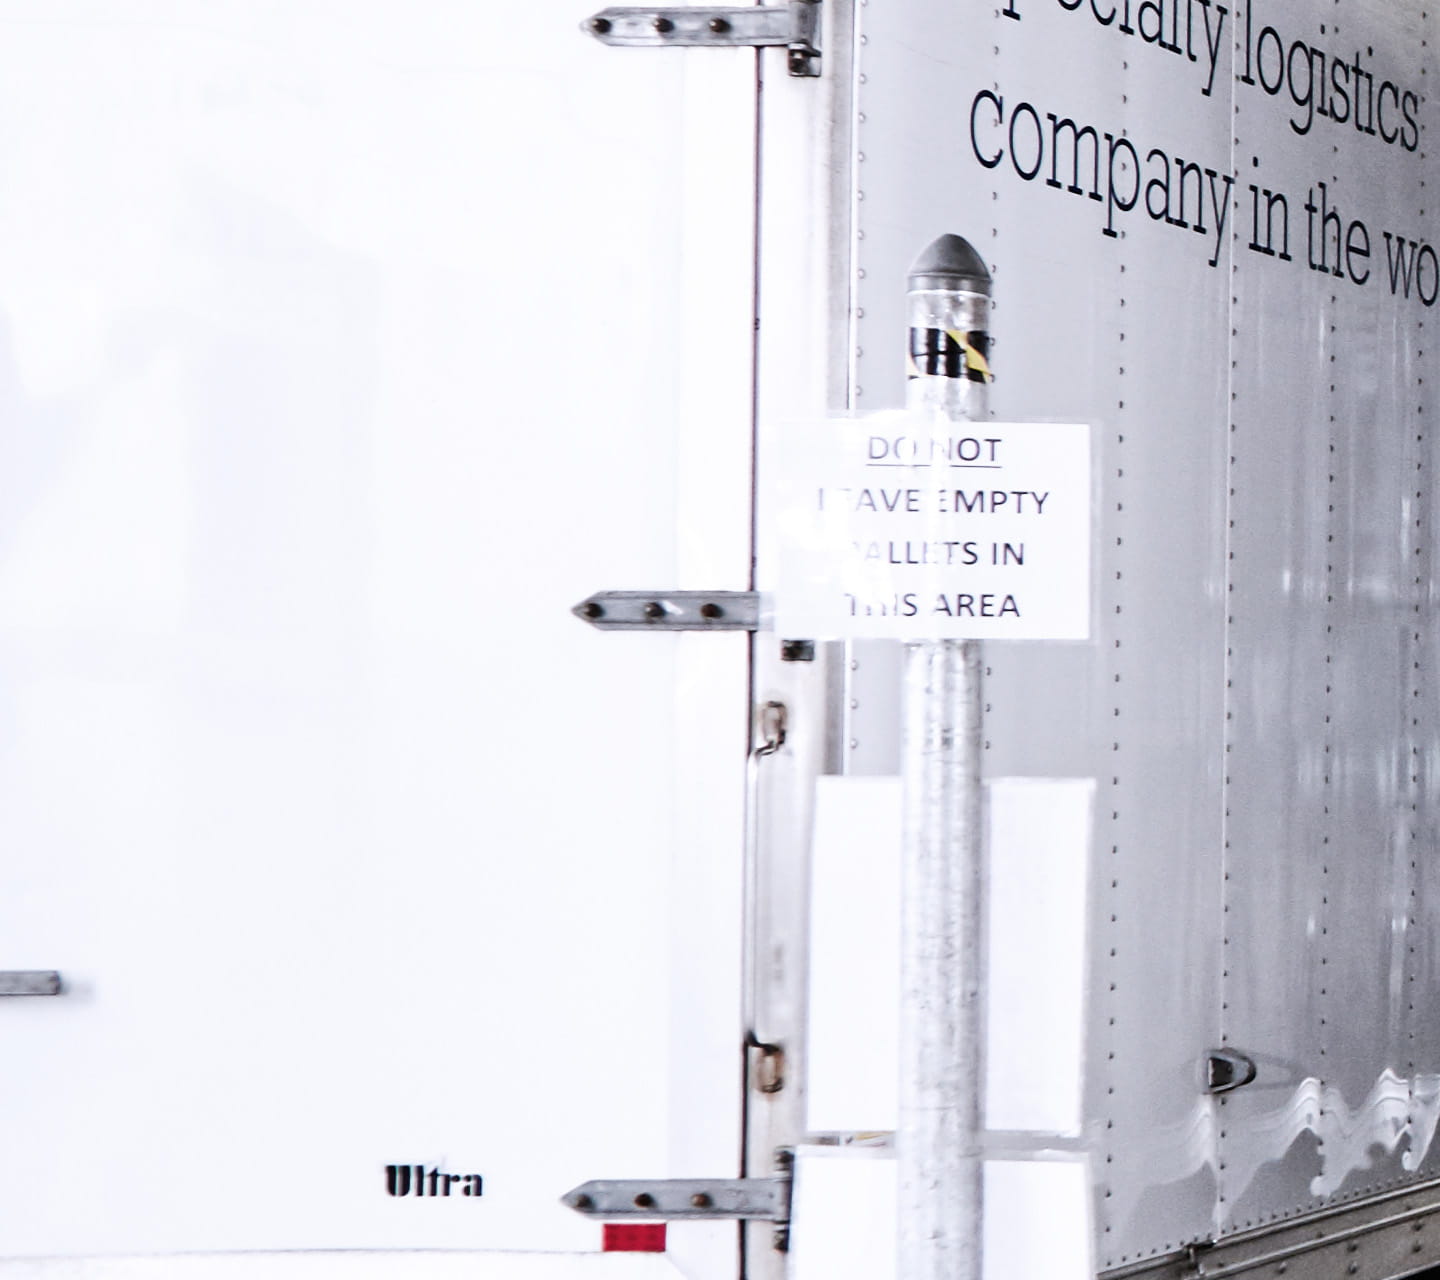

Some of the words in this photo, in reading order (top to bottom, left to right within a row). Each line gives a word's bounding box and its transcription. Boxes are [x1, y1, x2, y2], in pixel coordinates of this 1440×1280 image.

[970, 89, 1233, 267] company
[1249, 156, 1292, 263] in
[1304, 182, 1371, 286] the
[991, 541, 1026, 567] IN
[932, 593, 1021, 618] AREA
[384, 1164, 485, 1199] Ultra
